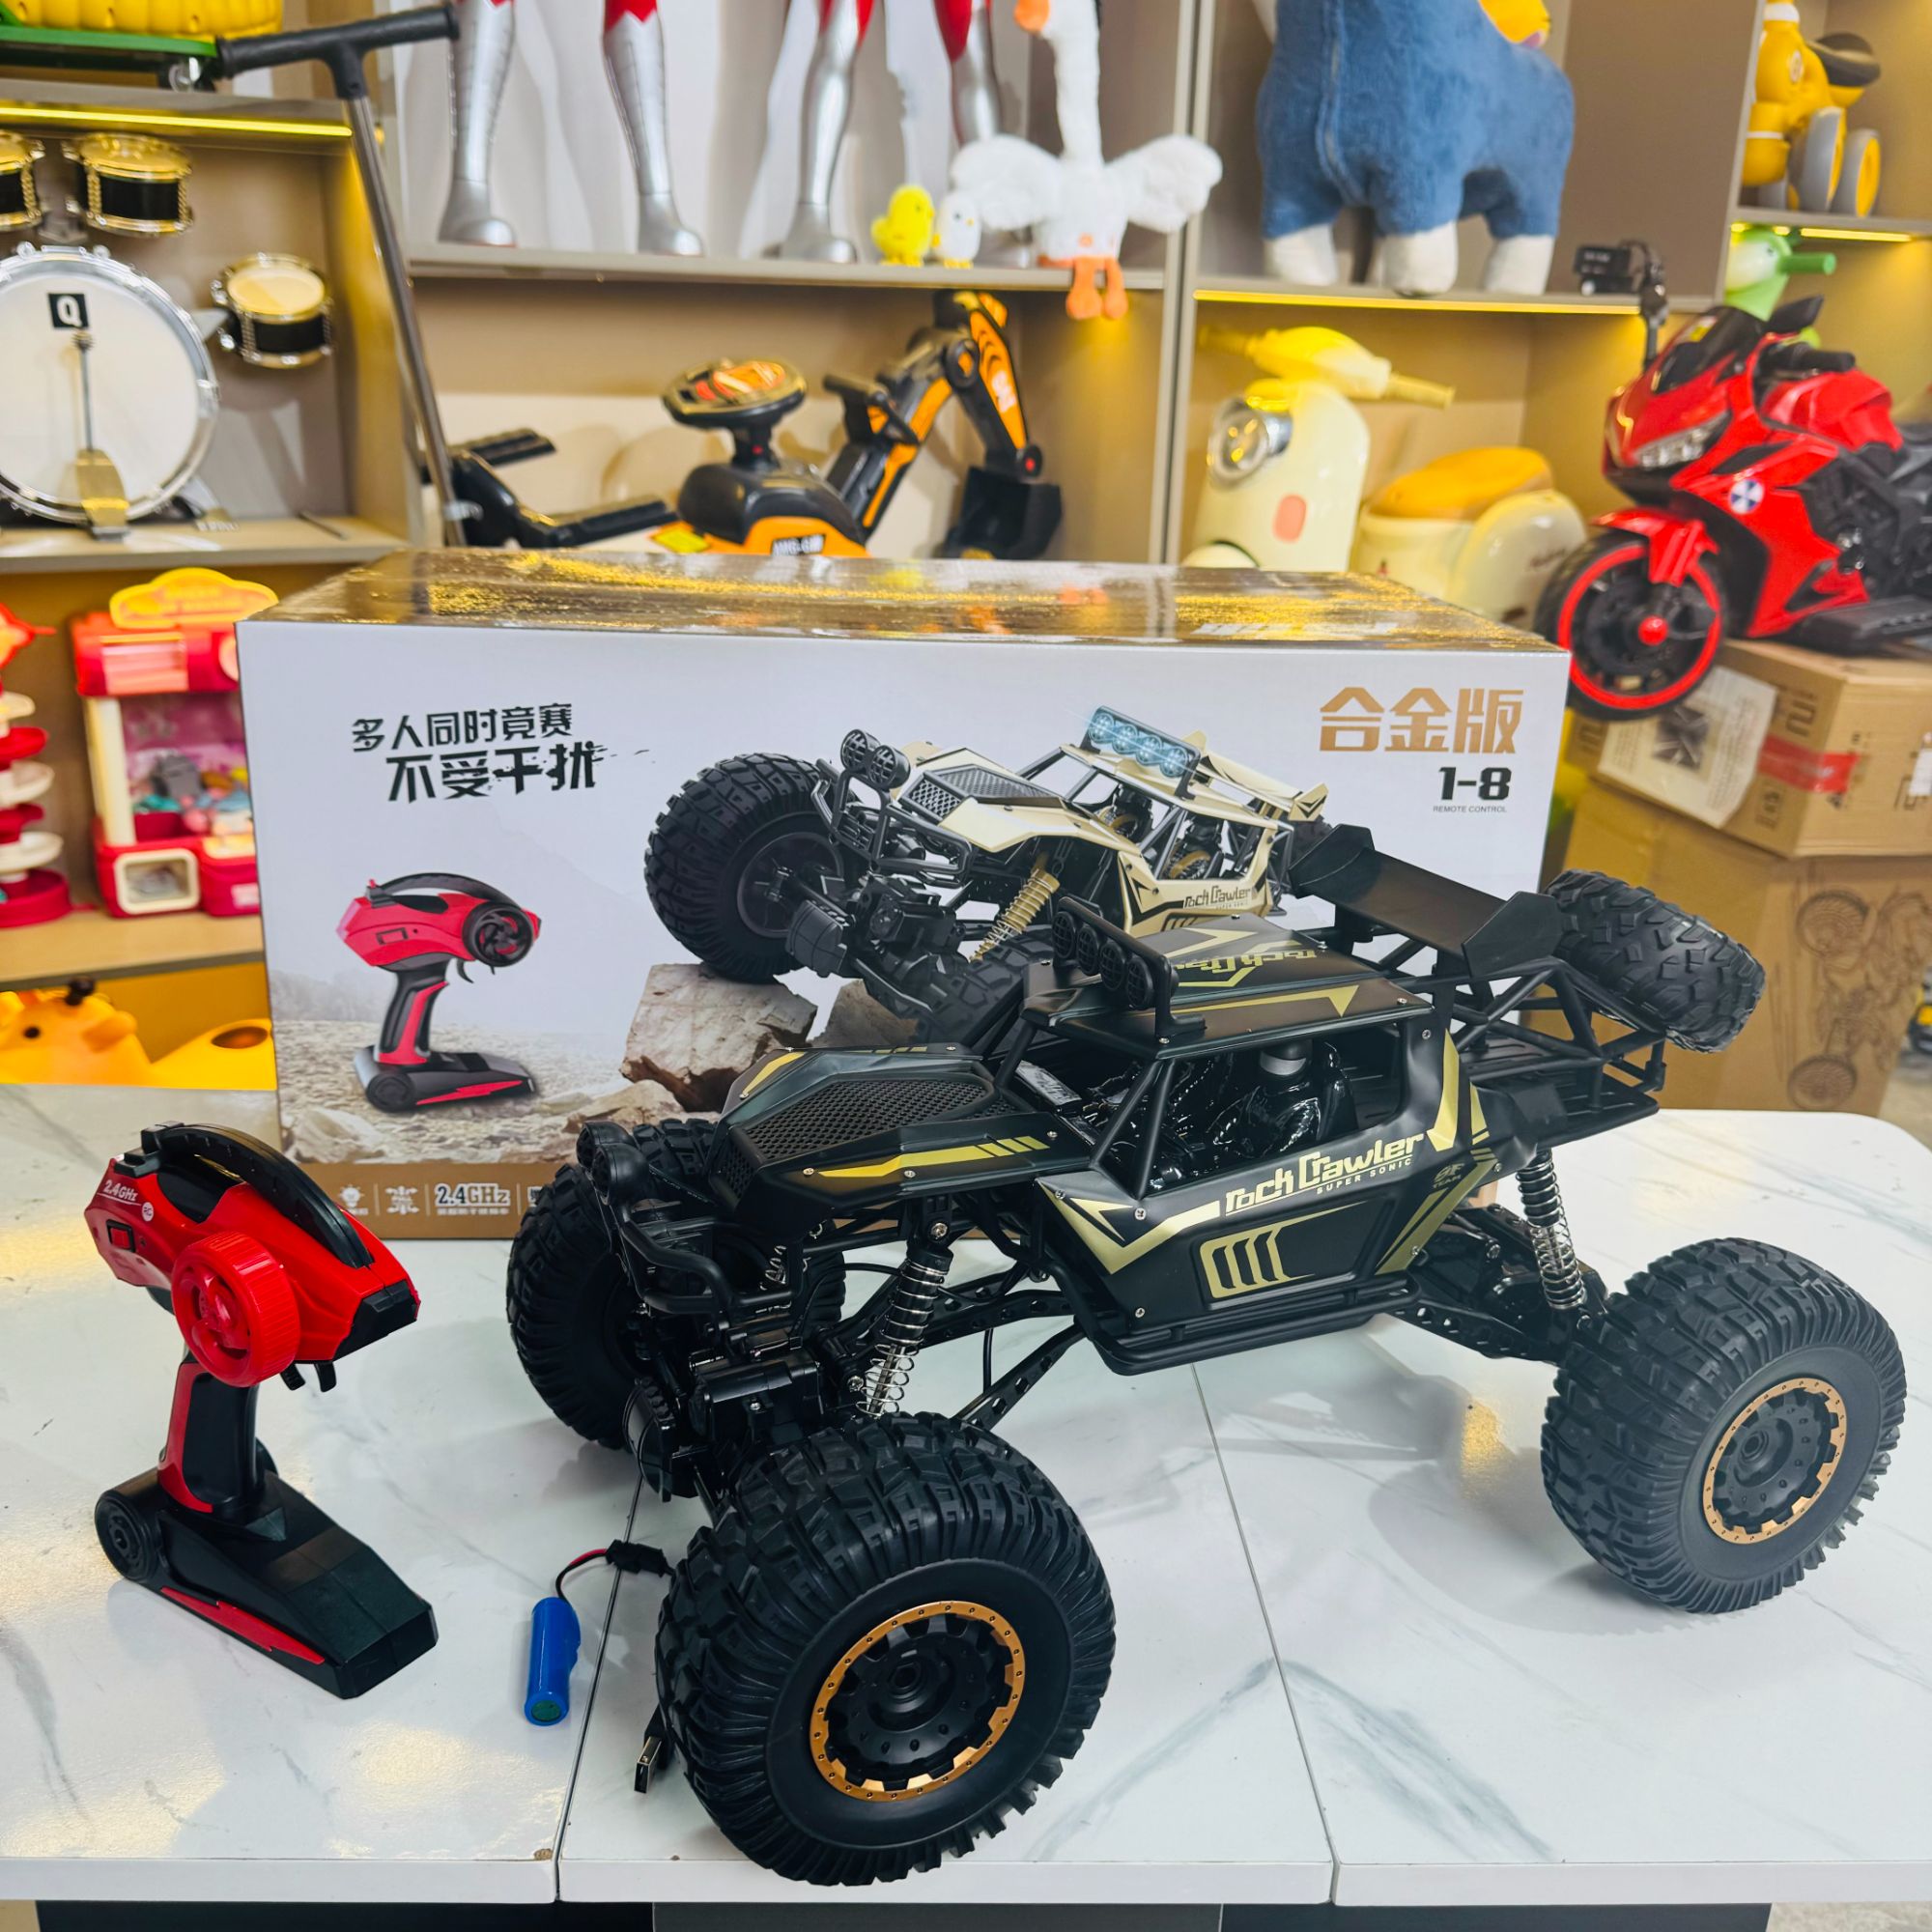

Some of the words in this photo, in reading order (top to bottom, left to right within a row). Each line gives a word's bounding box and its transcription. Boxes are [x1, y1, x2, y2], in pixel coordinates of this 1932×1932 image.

[56, 295, 83, 327] Q
[1319, 686, 1524, 754] 合金版
[385, 740, 607, 804] 不受干扰
[1438, 766, 1513, 801] 1-8
[1433, 805, 1467, 813] REMOTE
[1468, 805, 1508, 813] CONTROL
[1316, 1175, 1362, 1195] SUPER
[1369, 1157, 1413, 1178] SONIC
[436, 1183, 510, 1207] 2.4GHz
